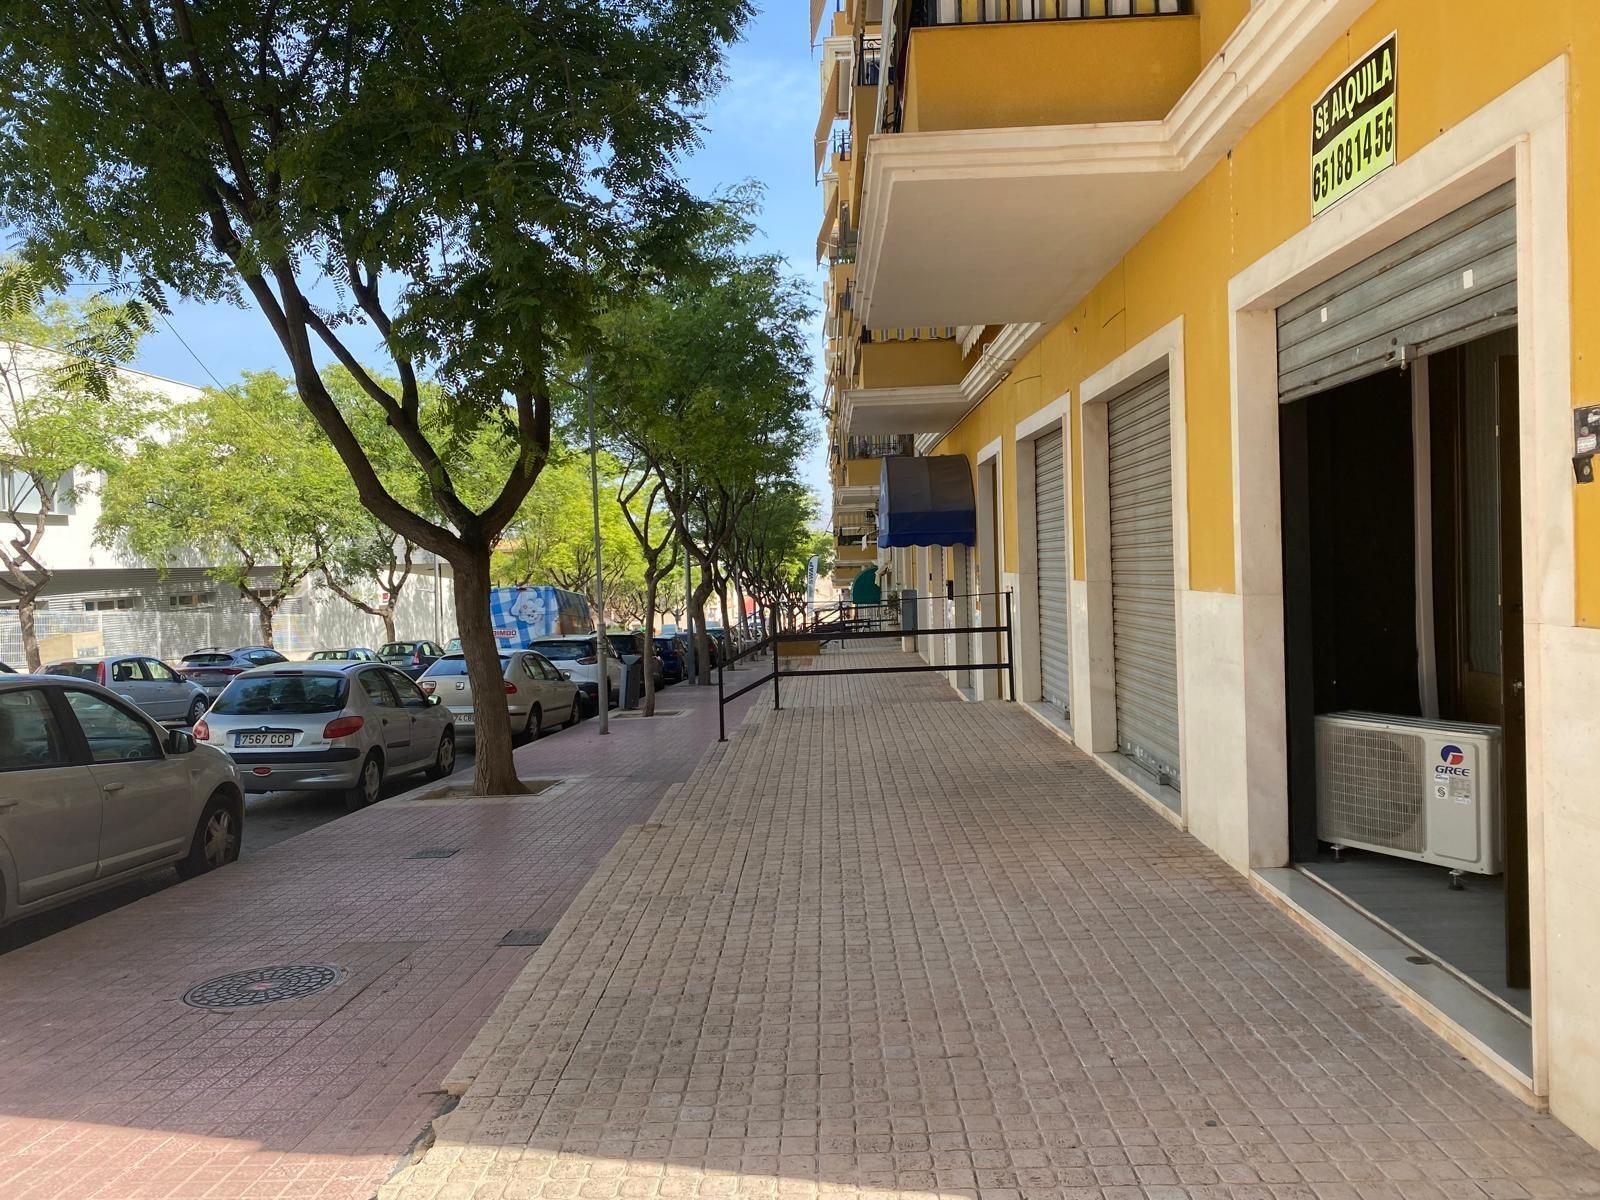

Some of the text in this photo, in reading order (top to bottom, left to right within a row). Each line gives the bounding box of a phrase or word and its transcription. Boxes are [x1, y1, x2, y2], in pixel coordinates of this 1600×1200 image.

[1315, 48, 1393, 140] SE ALQUILA
[1313, 106, 1393, 202] 651881456
[242, 734, 291, 745] 7567 CCP
[1435, 765, 1471, 777] GREE
